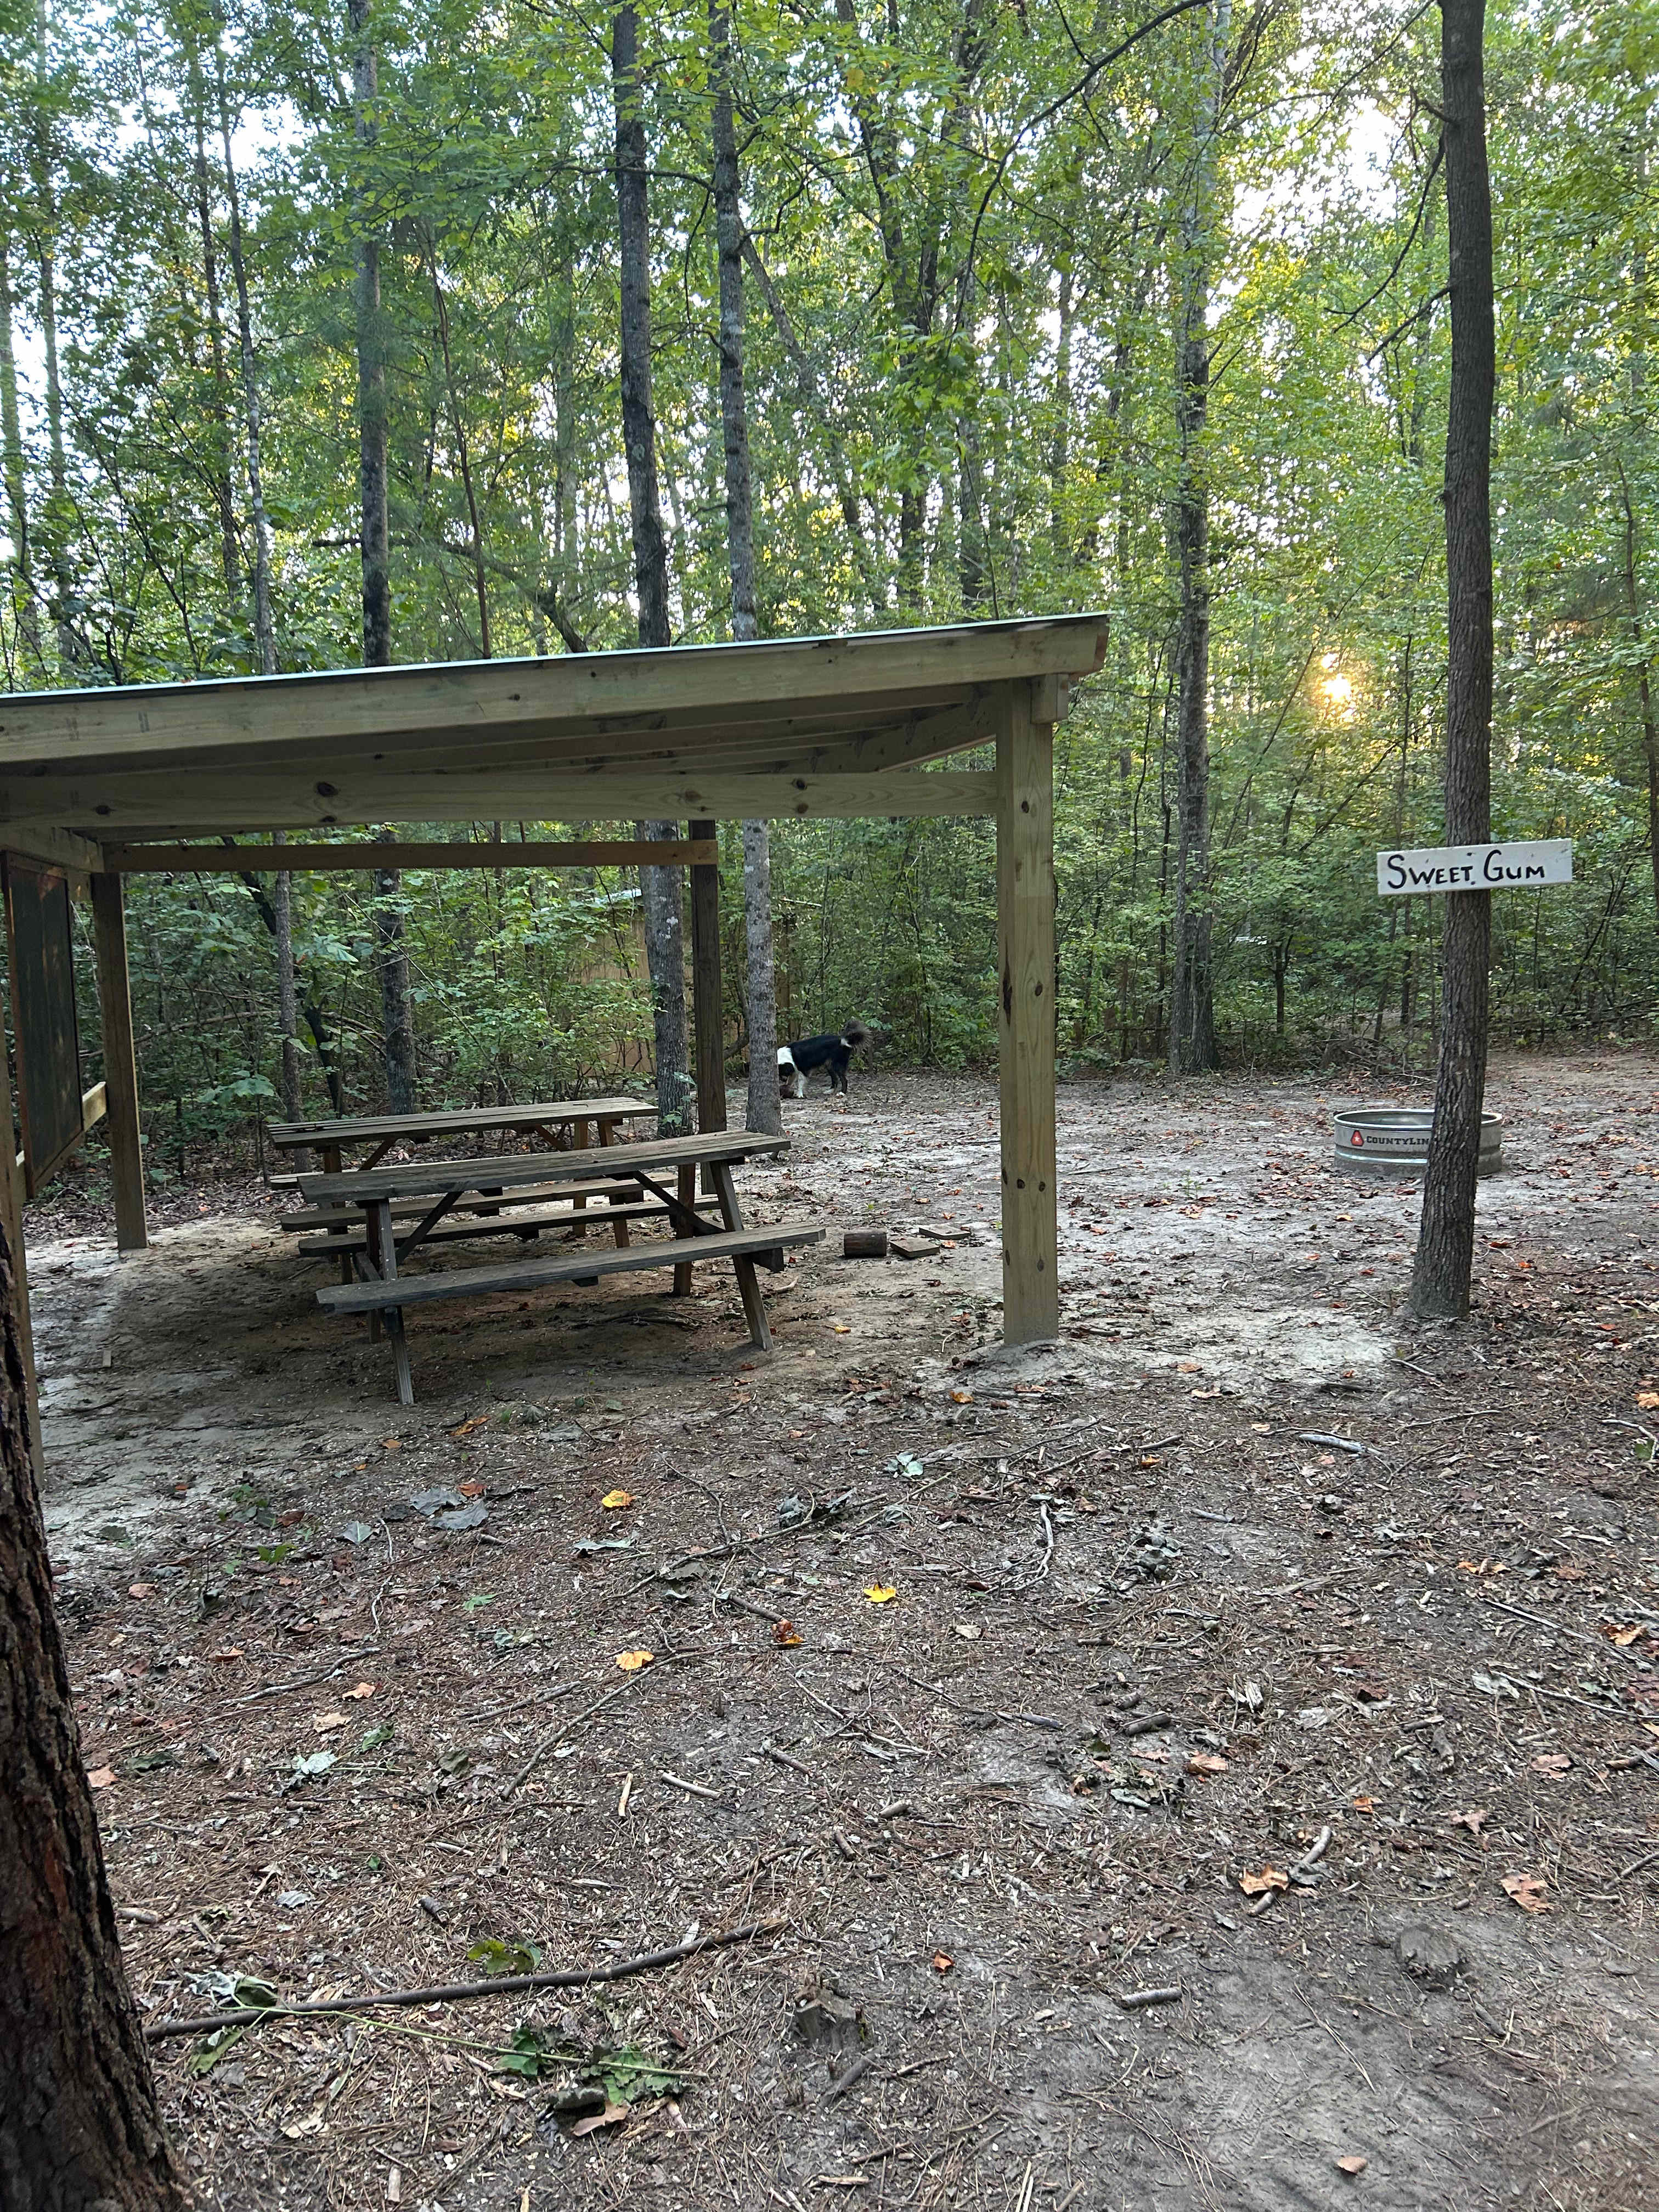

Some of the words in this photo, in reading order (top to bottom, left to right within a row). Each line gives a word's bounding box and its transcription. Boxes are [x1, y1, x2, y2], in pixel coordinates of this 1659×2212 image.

[1387, 854, 1473, 889] SWEET
[1483, 849, 1545, 882] GUM
[1366, 1136, 1430, 1146] COUNTYLIN
